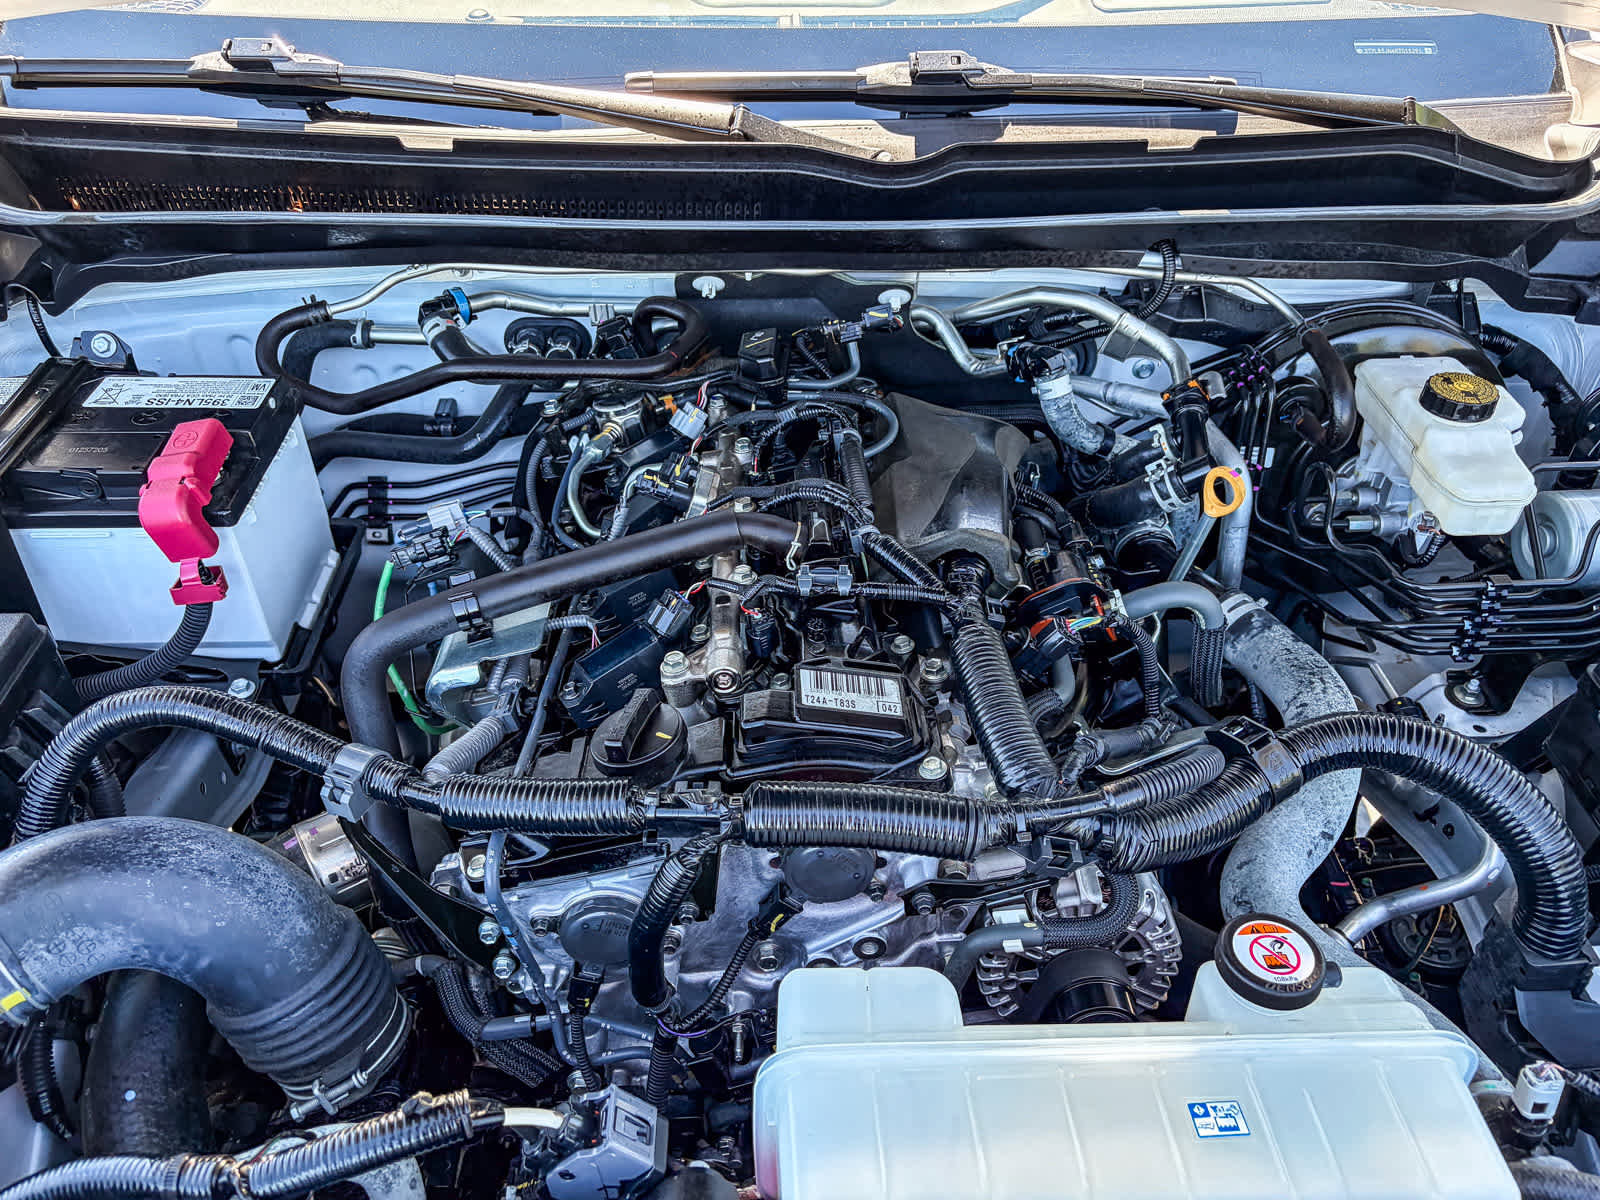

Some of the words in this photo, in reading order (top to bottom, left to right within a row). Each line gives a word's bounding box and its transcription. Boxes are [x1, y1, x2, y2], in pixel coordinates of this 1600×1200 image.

[251, 383, 266, 391] VM
[145, 398, 230, 407] 395LN4-ISS
[881, 702, 898, 714] 042
[1264, 979, 1312, 992] DENSO
